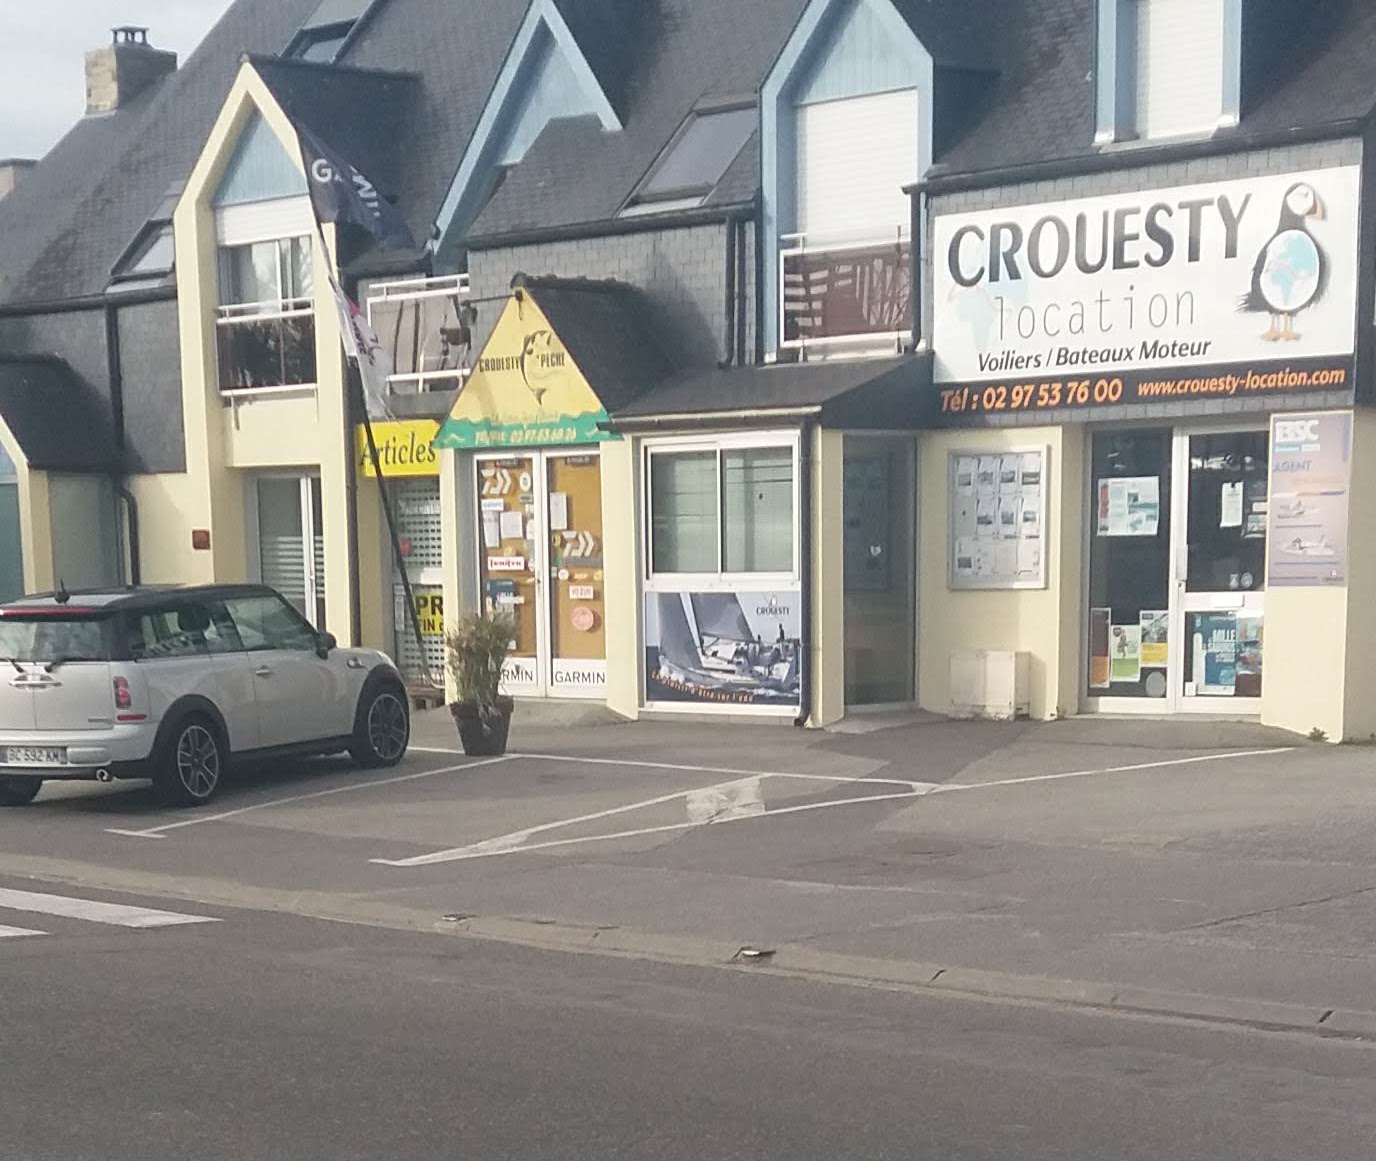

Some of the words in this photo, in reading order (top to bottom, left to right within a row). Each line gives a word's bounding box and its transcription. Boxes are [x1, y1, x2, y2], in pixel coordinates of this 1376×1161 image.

[947, 193, 1253, 287] CROUESTY
[994, 284, 1195, 341] location
[977, 347, 1042, 373] Voiliers
[1056, 344, 1134, 367] Bateaux
[1139, 339, 1212, 361] Moteur
[940, 387, 970, 413] Tél
[982, 386, 1007, 411] 02
[1010, 383, 1035, 409] 97
[1037, 381, 1063, 407] 53
[1066, 379, 1090, 404] 76
[1094, 377, 1123, 402] 00
[1137, 366, 1345, 397] www.crouesty-location.com
[360, 432, 436, 466] Aticles
[504, 668, 533, 682] RMIN
[555, 670, 605, 684] GARMIN
